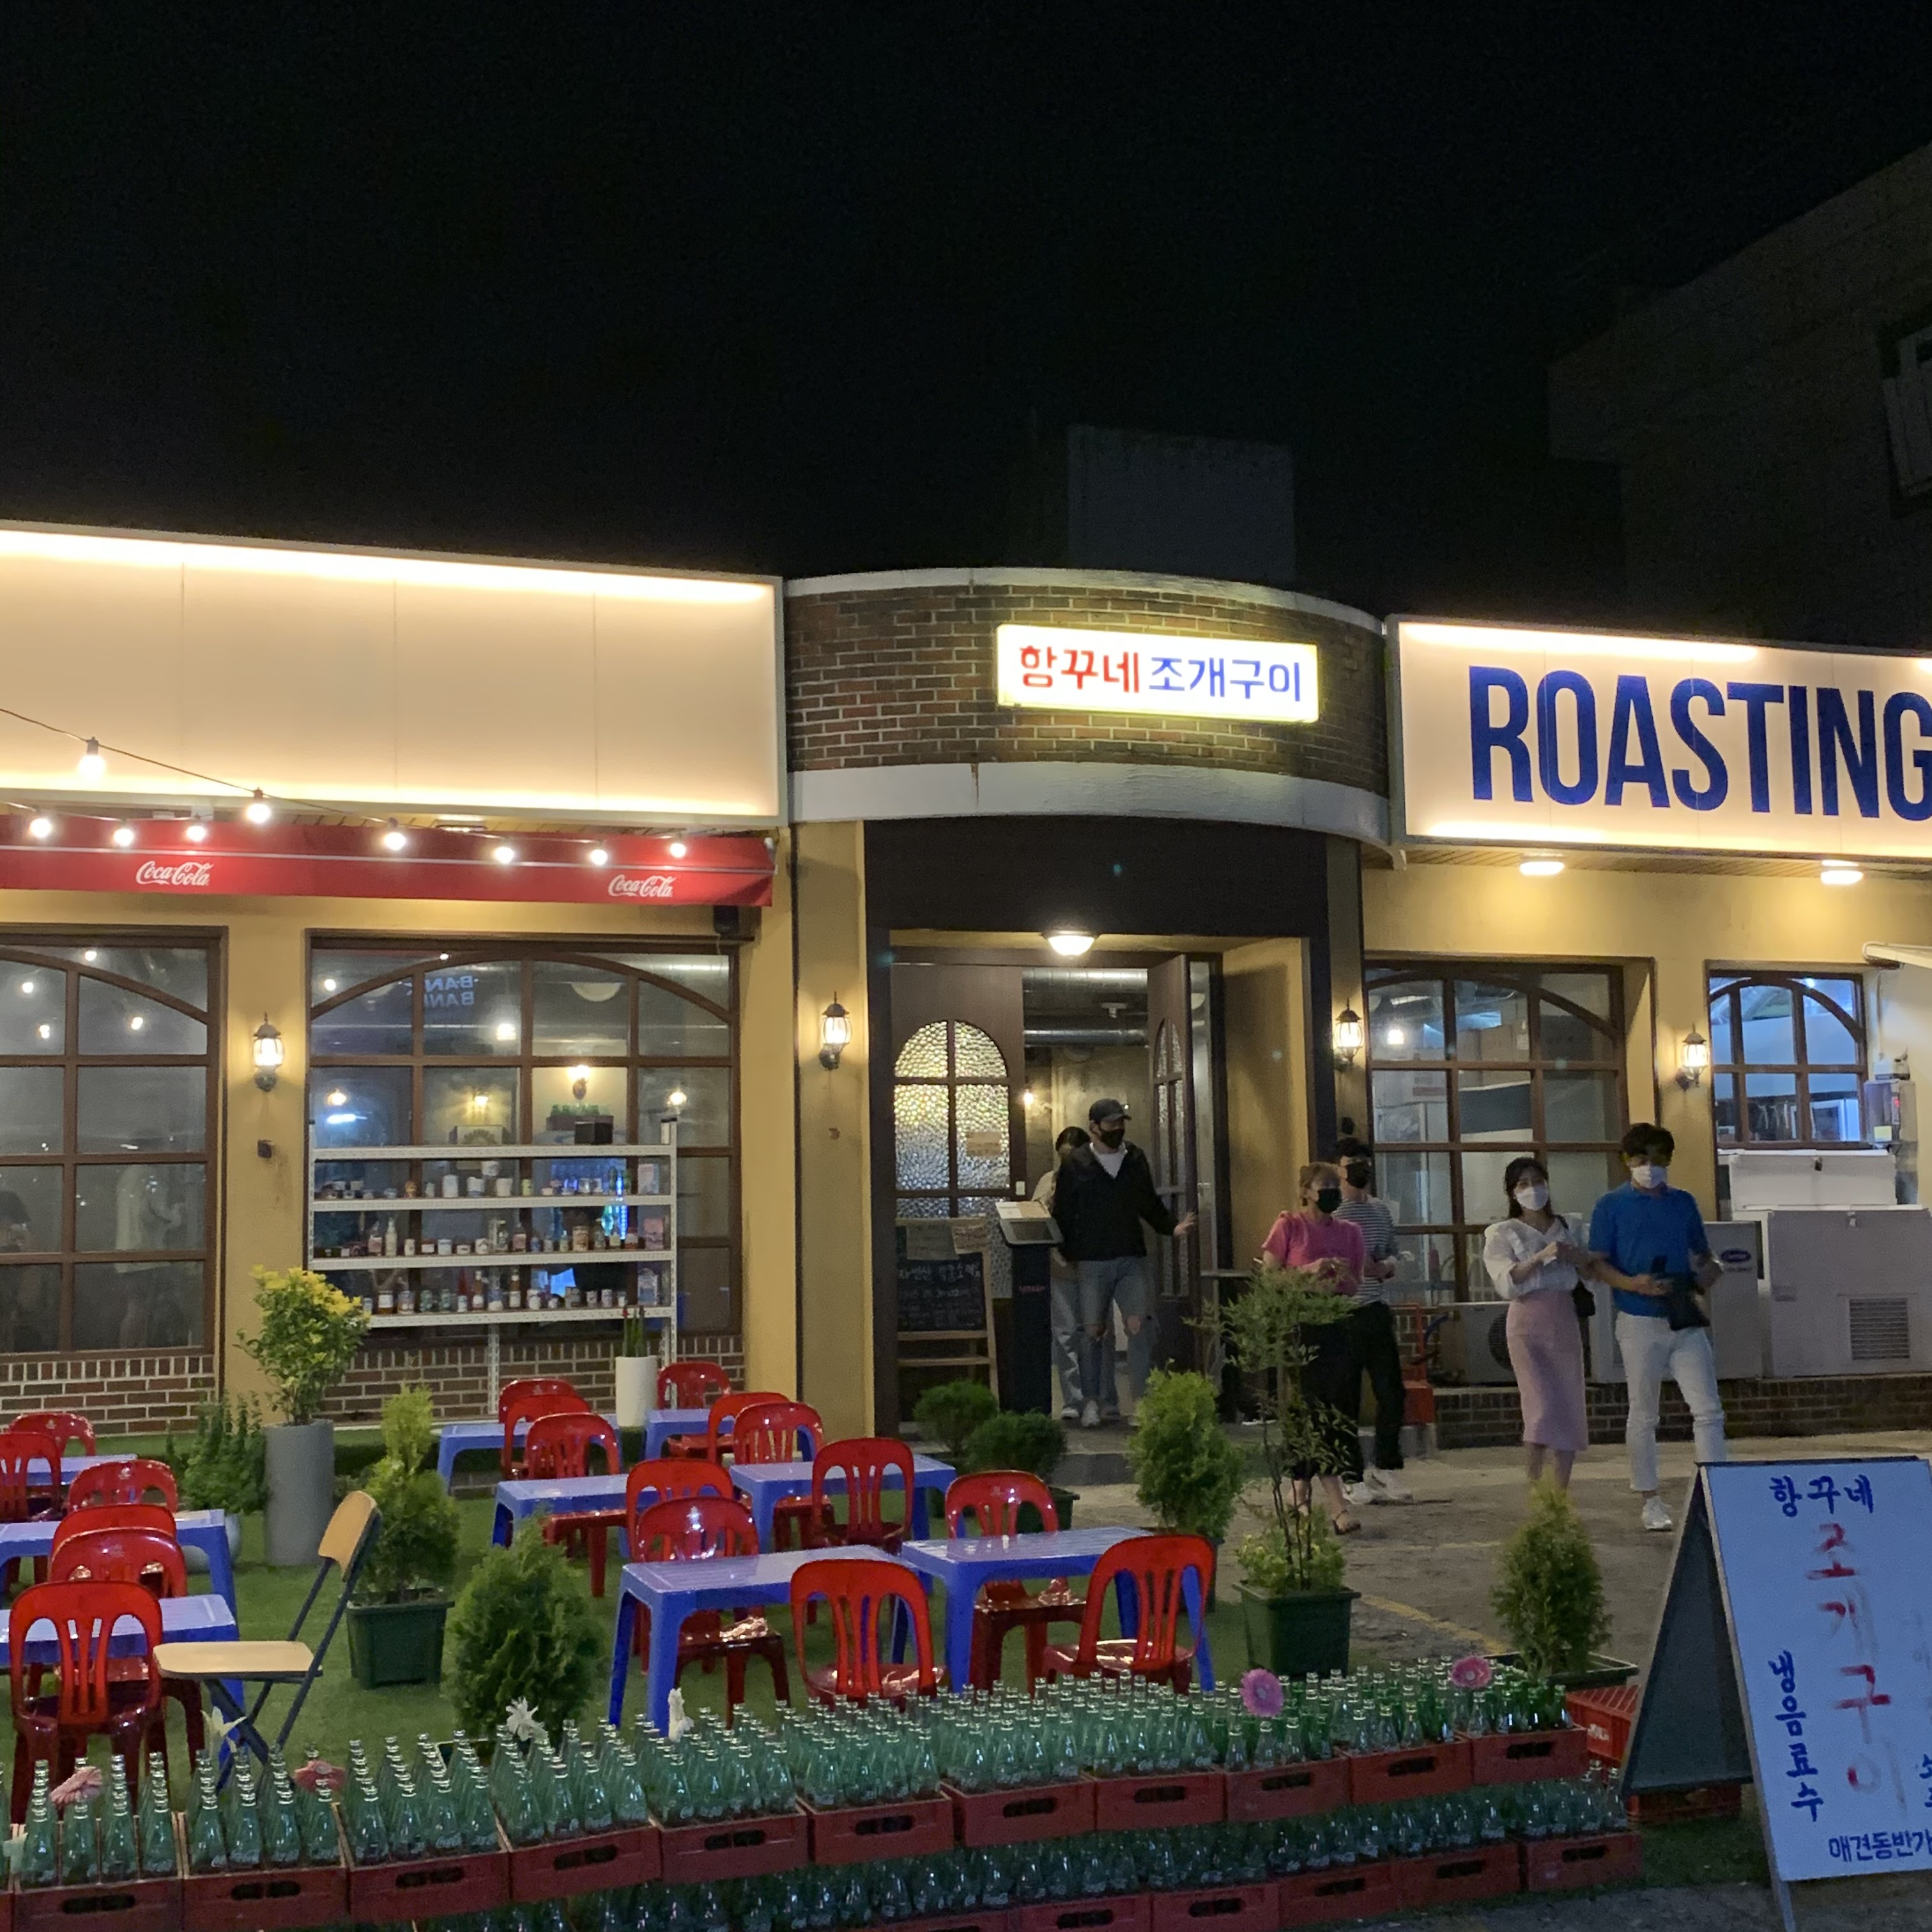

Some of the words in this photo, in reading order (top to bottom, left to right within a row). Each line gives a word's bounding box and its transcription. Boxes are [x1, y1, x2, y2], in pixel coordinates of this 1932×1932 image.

[1149, 657, 1301, 702] 조개구이
[1469, 665, 1932, 820] ROASTING
[135, 860, 214, 886] Coca-Cola
[608, 874, 677, 898] Coca-Cola
[1768, 1650, 1824, 1822] 냉음료수
